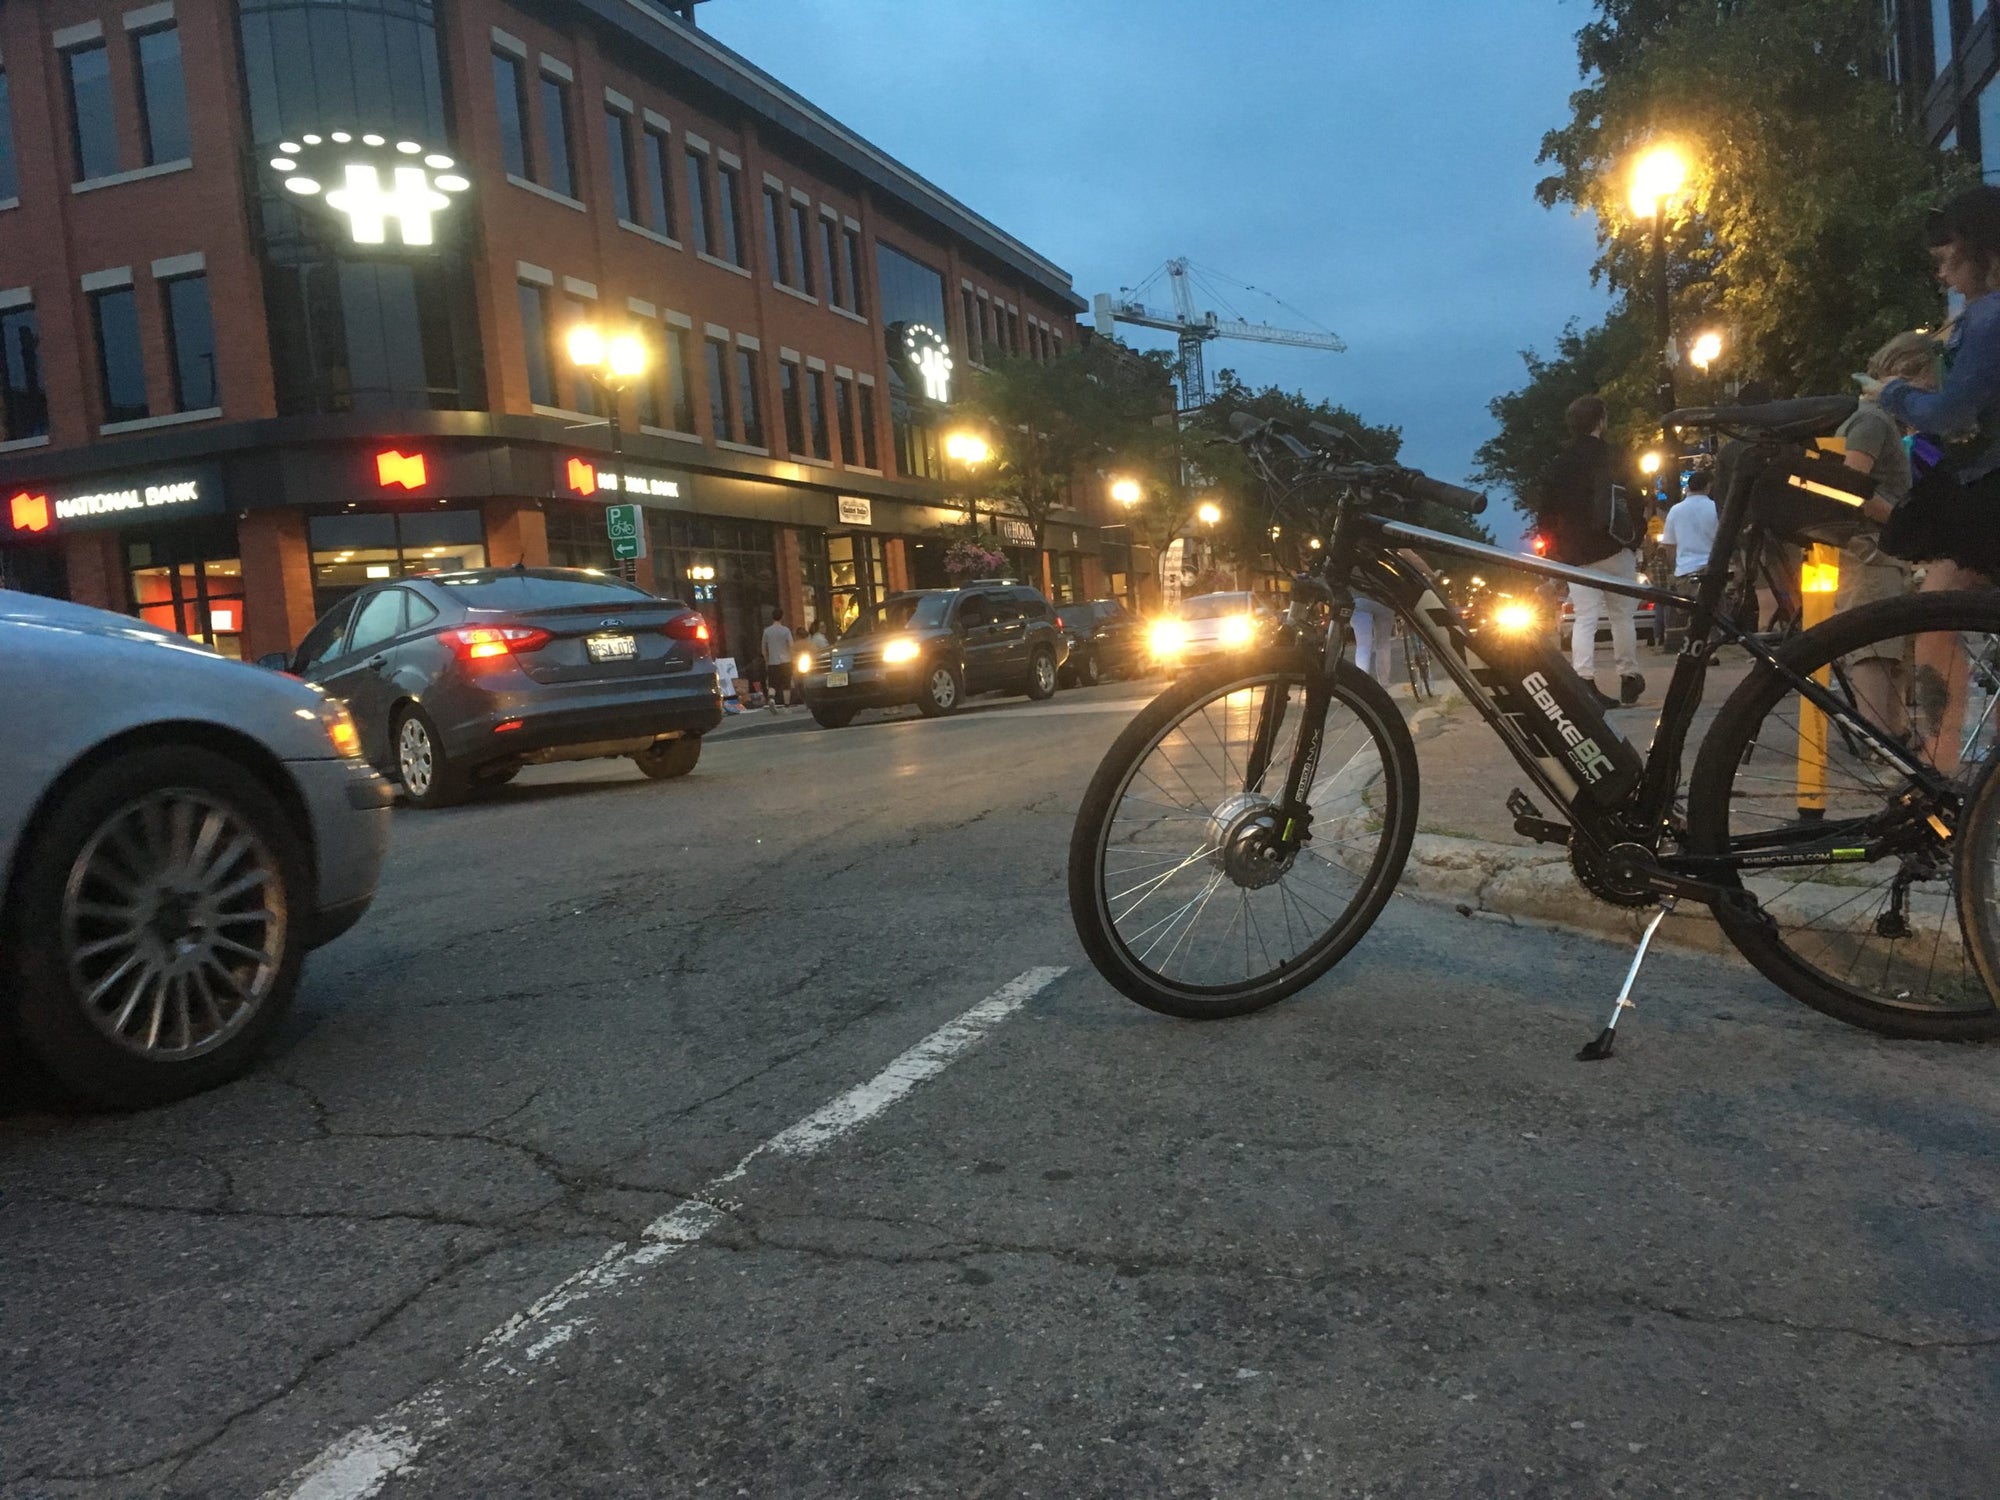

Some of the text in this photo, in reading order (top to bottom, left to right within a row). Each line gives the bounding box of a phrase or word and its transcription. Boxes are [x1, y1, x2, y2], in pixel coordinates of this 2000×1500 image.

[55, 481, 198, 518] NATIONAL BANK
[610, 508, 621, 524] P
[1521, 671, 1616, 780] EBIKEBC
[1306, 728, 1320, 761] NVX
